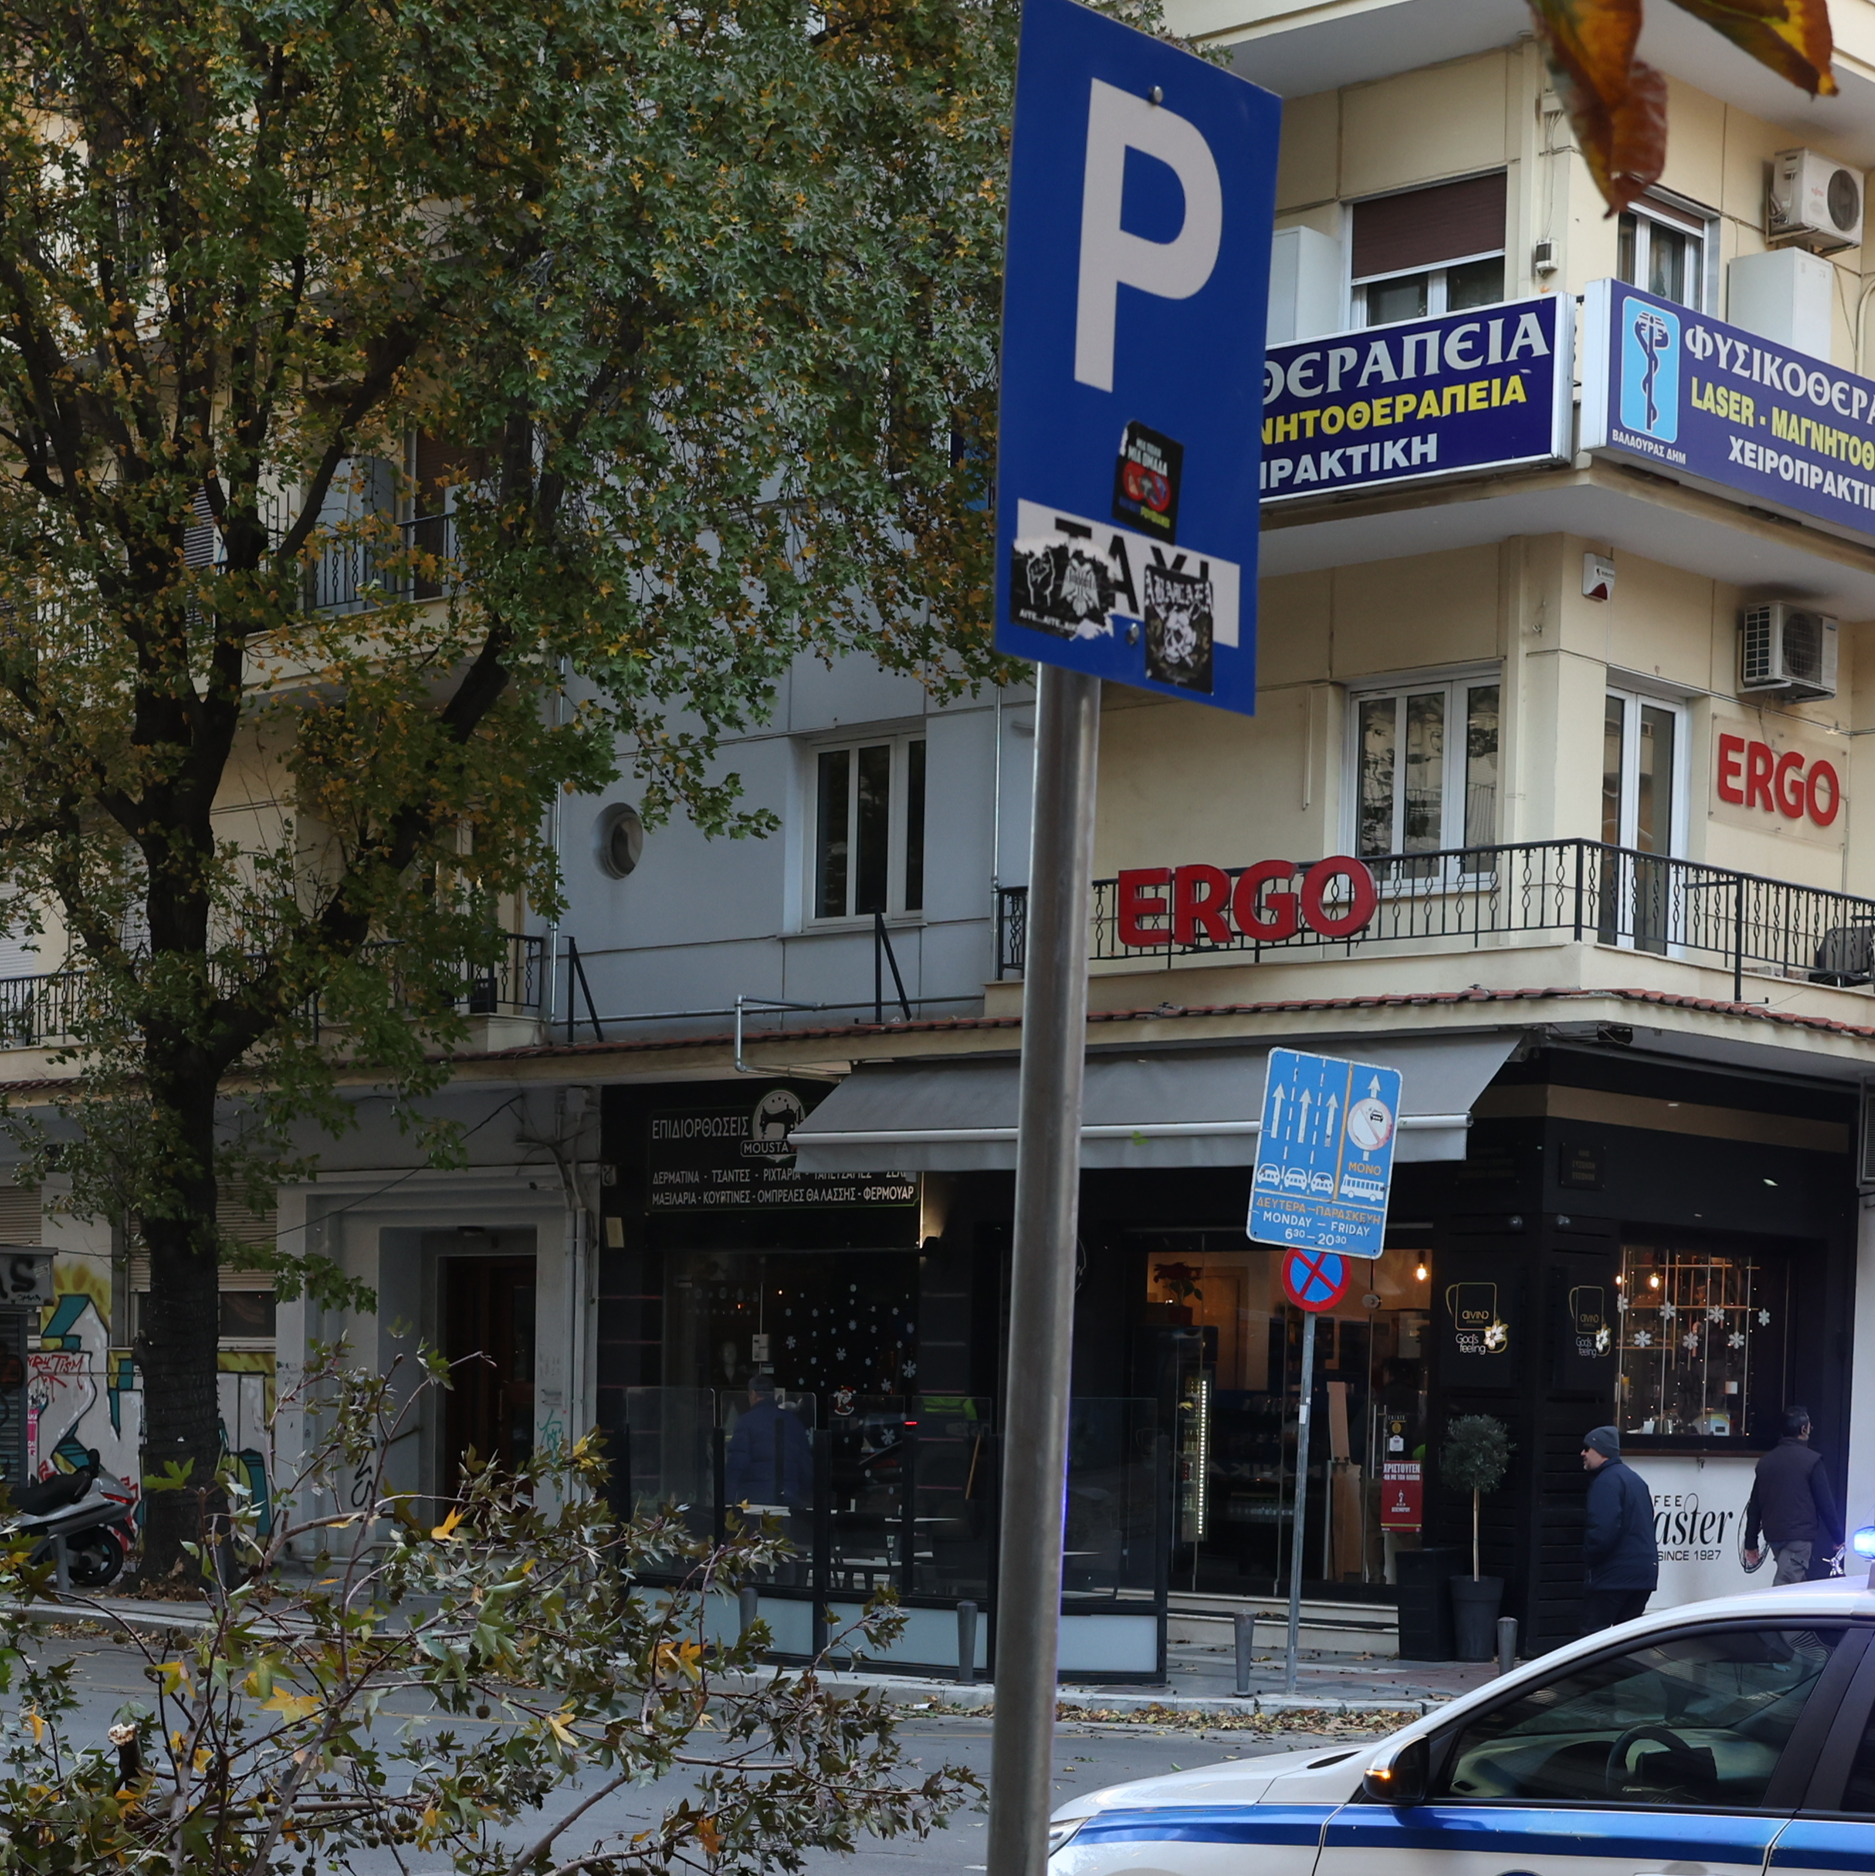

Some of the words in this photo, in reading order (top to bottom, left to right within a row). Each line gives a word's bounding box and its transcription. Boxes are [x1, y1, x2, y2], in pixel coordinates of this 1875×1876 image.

[1074, 76, 1223, 394] P
[1262, 311, 1551, 405] ΘΕΡΑΠΕΙΑ
[1262, 373, 1527, 446] ΝΗΤΟΘΕΡΑΠΕΙΑ
[1690, 375, 1755, 428] LASER
[1611, 427, 1666, 463] ΒΑΛΑΟΥΡΑΣ
[1261, 432, 1438, 492] ΡΑΚΤΙΚΗ
[1717, 732, 1841, 828] ERGO
[1117, 855, 1378, 949] ERGO
[651, 1116, 749, 1140] ΕΠΙΔΙΟΡΘΩΣΕΙΣ
[743, 1141, 789, 1154] MOUSTA
[652, 1170, 700, 1185] ΔΕΡΜΑΤΙΝΑ
[711, 1168, 751, 1184] ΤΣΑΝΤΕΣ
[1348, 1161, 1382, 1176] ΜΟΝΟ
[652, 1191, 697, 1206] ΜΑΞΙΛΑΡΙΑ
[702, 1189, 751, 1205] ΚΟΥΡΤΙΝΕΣ
[757, 1188, 804, 1203] ΟΜΠΡΕΛΕΣ
[862, 1185, 915, 1201] ΦΕΡΜΟΥΑΡ
[1263, 1211, 1312, 1228] MONDAY
[1330, 1221, 1371, 1237] FRIDAY
[1455, 1332, 1479, 1345] God's
[1459, 1343, 1487, 1356] feeling
[1654, 1495, 1683, 1507] FEE
[1654, 1492, 1733, 1546] aster
[1657, 1550, 1690, 1562] SINCE
[1694, 1550, 1722, 1561] 1927
